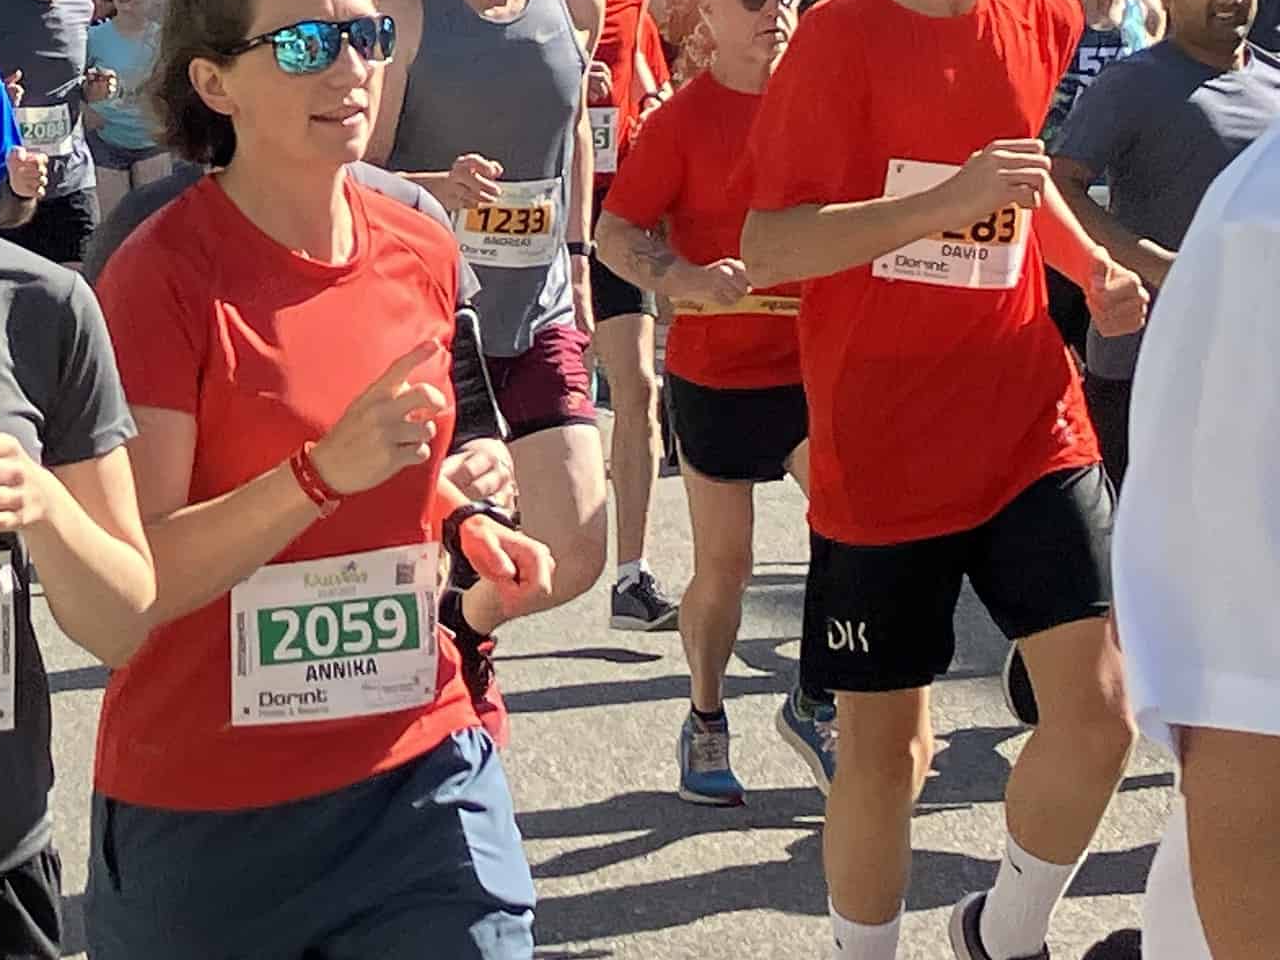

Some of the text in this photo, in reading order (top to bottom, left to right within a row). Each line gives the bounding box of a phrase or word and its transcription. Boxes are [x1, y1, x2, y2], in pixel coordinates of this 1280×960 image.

[477, 206, 544, 235] 1233
[941, 244, 989, 261] DAVID
[271, 597, 408, 662] 2059
[305, 658, 380, 683] ANNIKA
[258, 688, 329, 708] Dorint
